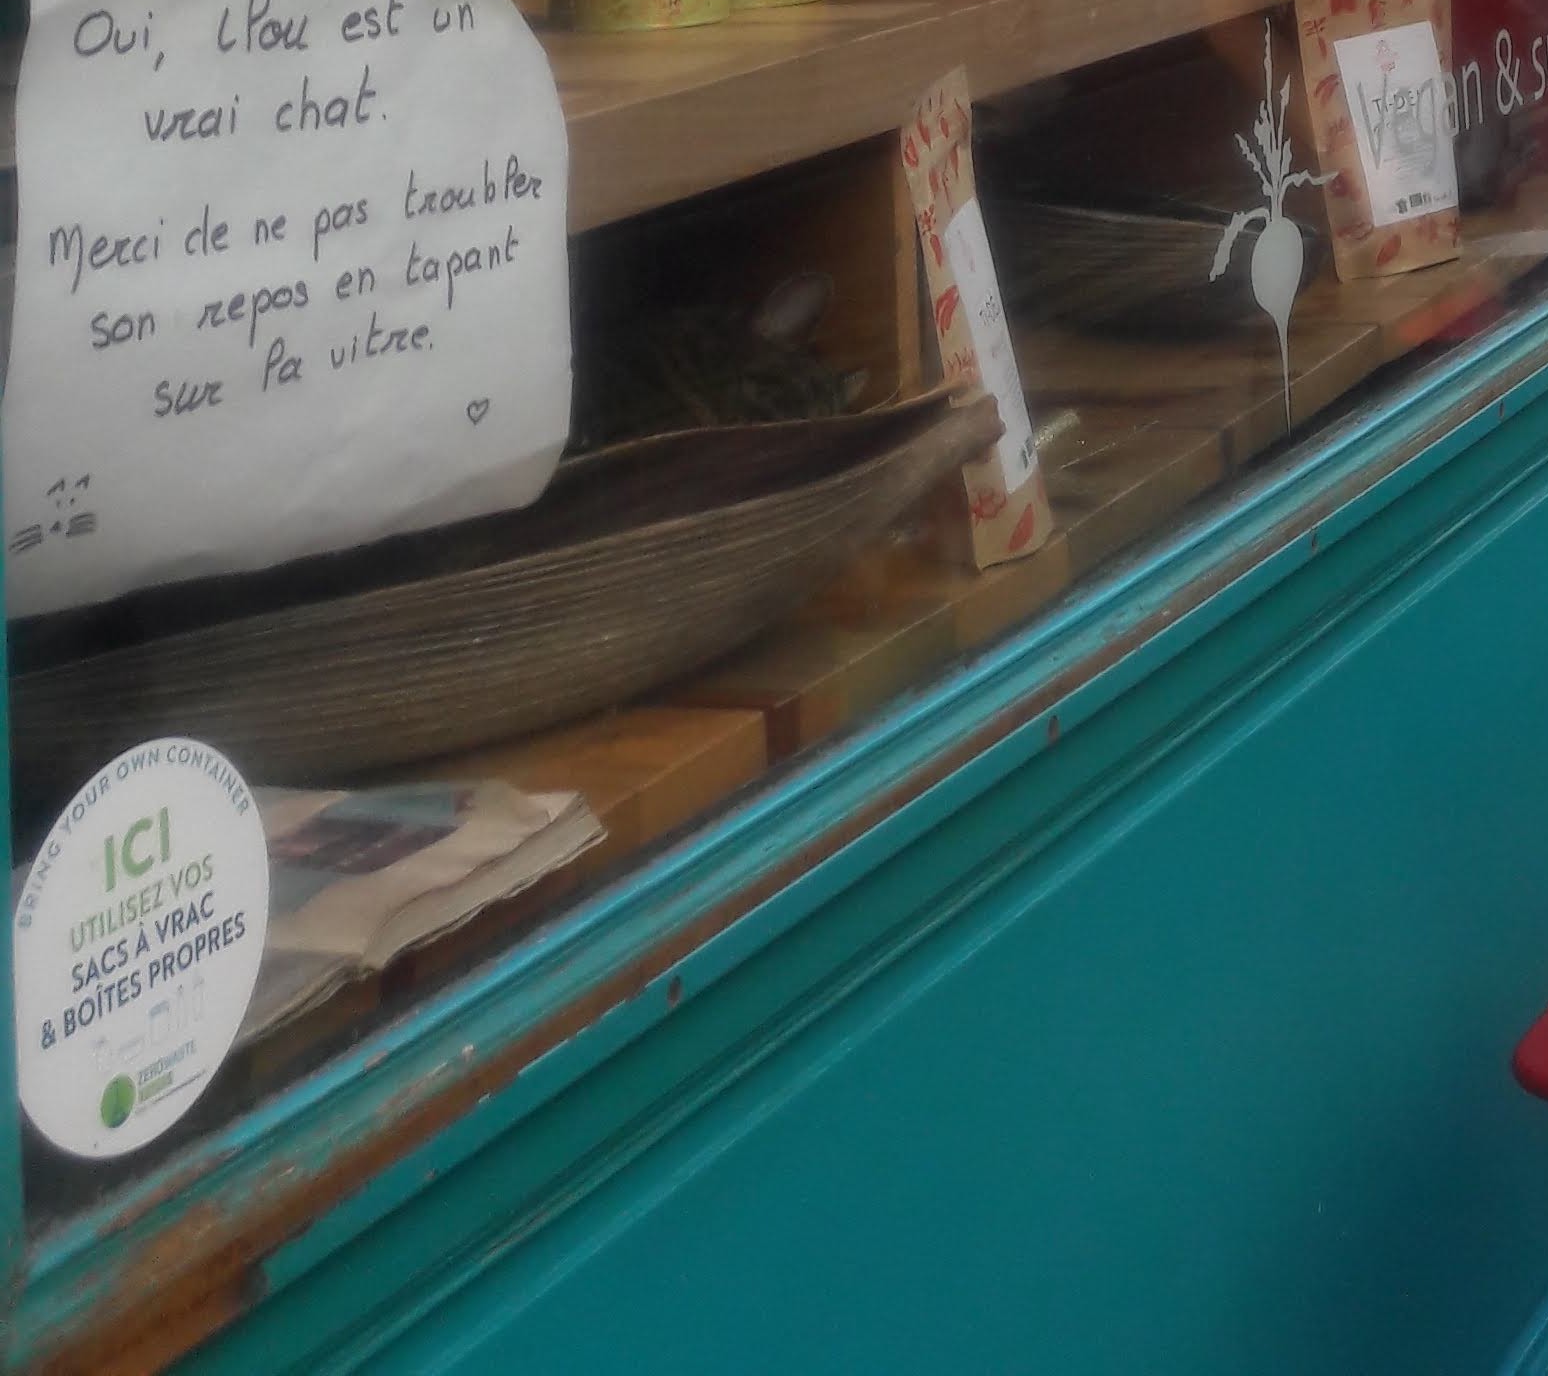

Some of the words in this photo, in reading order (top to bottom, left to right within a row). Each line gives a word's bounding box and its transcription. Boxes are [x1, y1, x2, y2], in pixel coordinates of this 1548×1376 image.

[74, 9, 165, 71] Oui,
[433, 0, 475, 34] un
[1495, 28, 1525, 116] &
[144, 92, 241, 142] vrai
[275, 65, 388, 131] chat.
[49, 219, 165, 294] Merci
[184, 203, 230, 258] de
[255, 212, 287, 245] ne
[314, 195, 370, 261] pas
[403, 153, 543, 220] troubler
[90, 308, 157, 350] son
[197, 279, 311, 349] repos
[335, 264, 377, 300] en
[405, 224, 519, 310] tapant
[153, 378, 224, 418] sur
[262, 344, 302, 393] la
[330, 316, 434, 370] vitre.
[58, 775, 110, 835] YOUR
[116, 747, 160, 781] OWN
[166, 745, 249, 817] CONTAINER
[104, 805, 170, 893] ICI
[70, 879, 164, 953] UTILISEZ
[170, 852, 214, 898] VOS
[71, 938, 128, 993] SACS
[155, 889, 215, 945] VRAC
[63, 971, 142, 1038] BOÎTES
[149, 911, 246, 989] PROPRES
